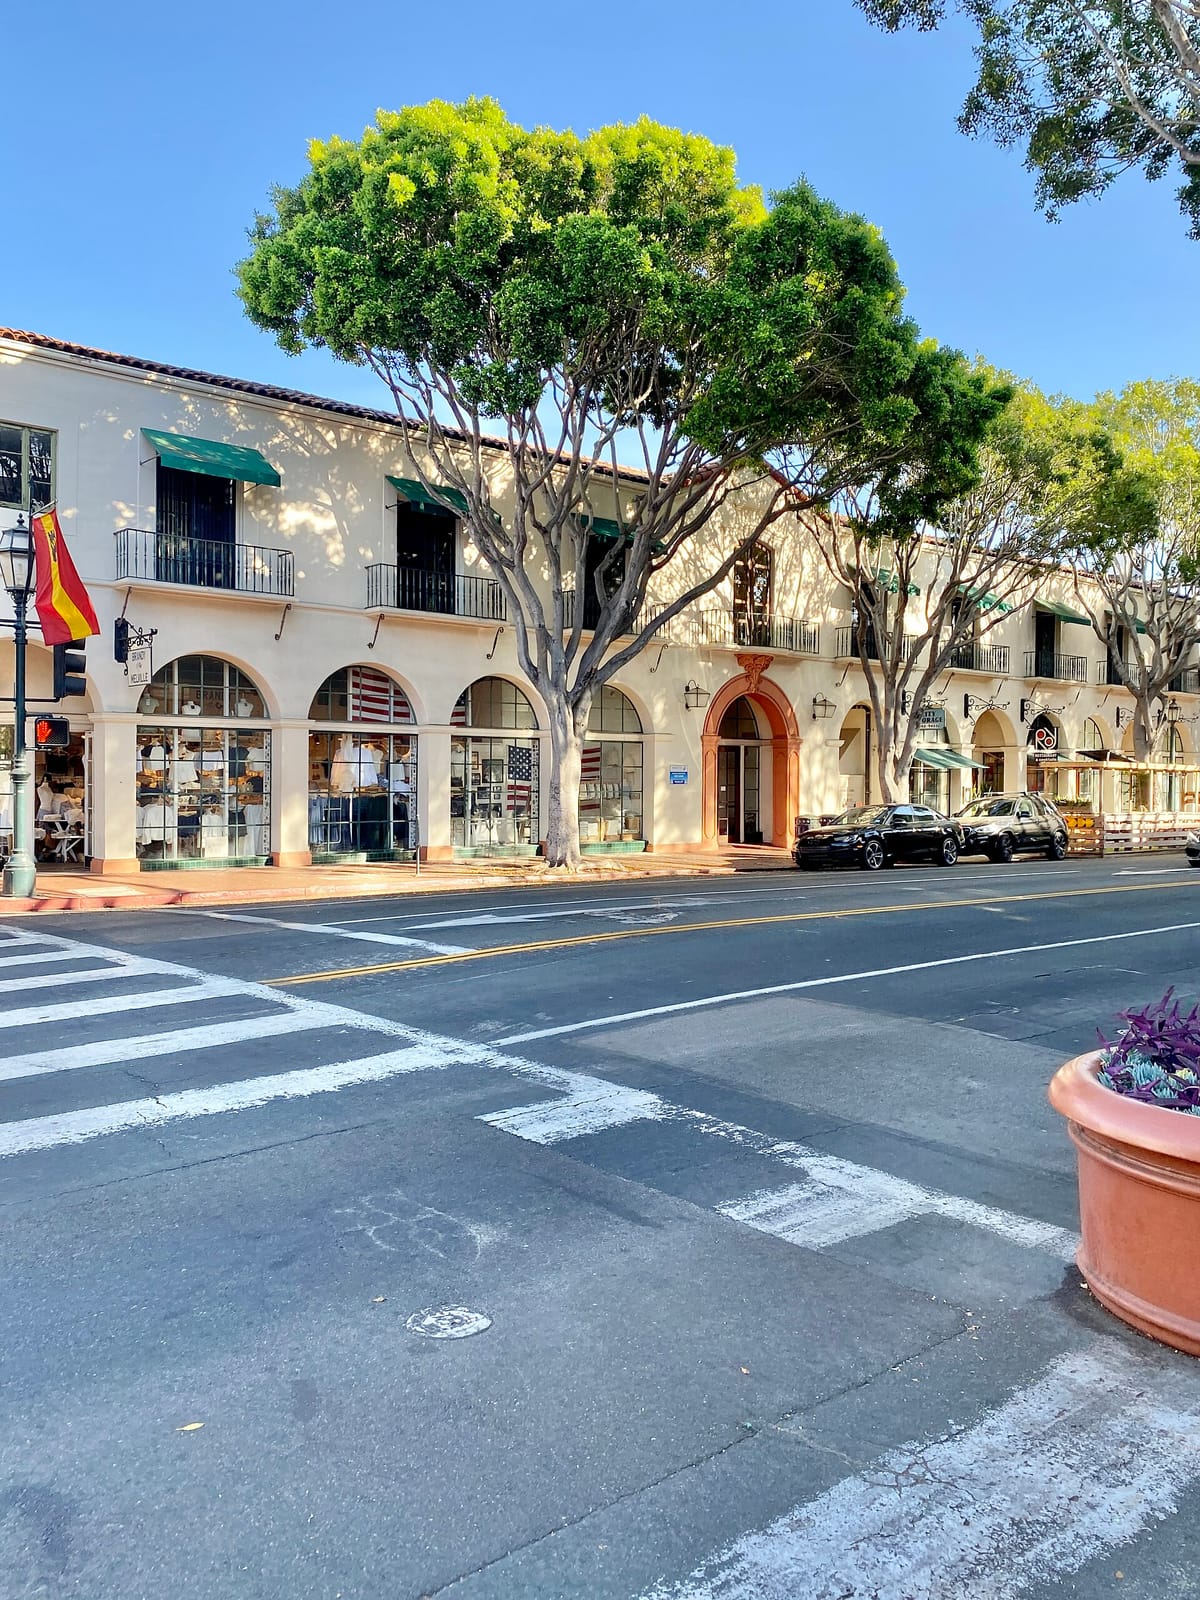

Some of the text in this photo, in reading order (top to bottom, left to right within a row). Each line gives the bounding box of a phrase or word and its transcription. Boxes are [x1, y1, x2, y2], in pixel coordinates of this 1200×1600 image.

[131, 651, 145, 661] BRANDY
[131, 672, 148, 683] MELVILLE
[196, 689, 224, 700] BRAN
